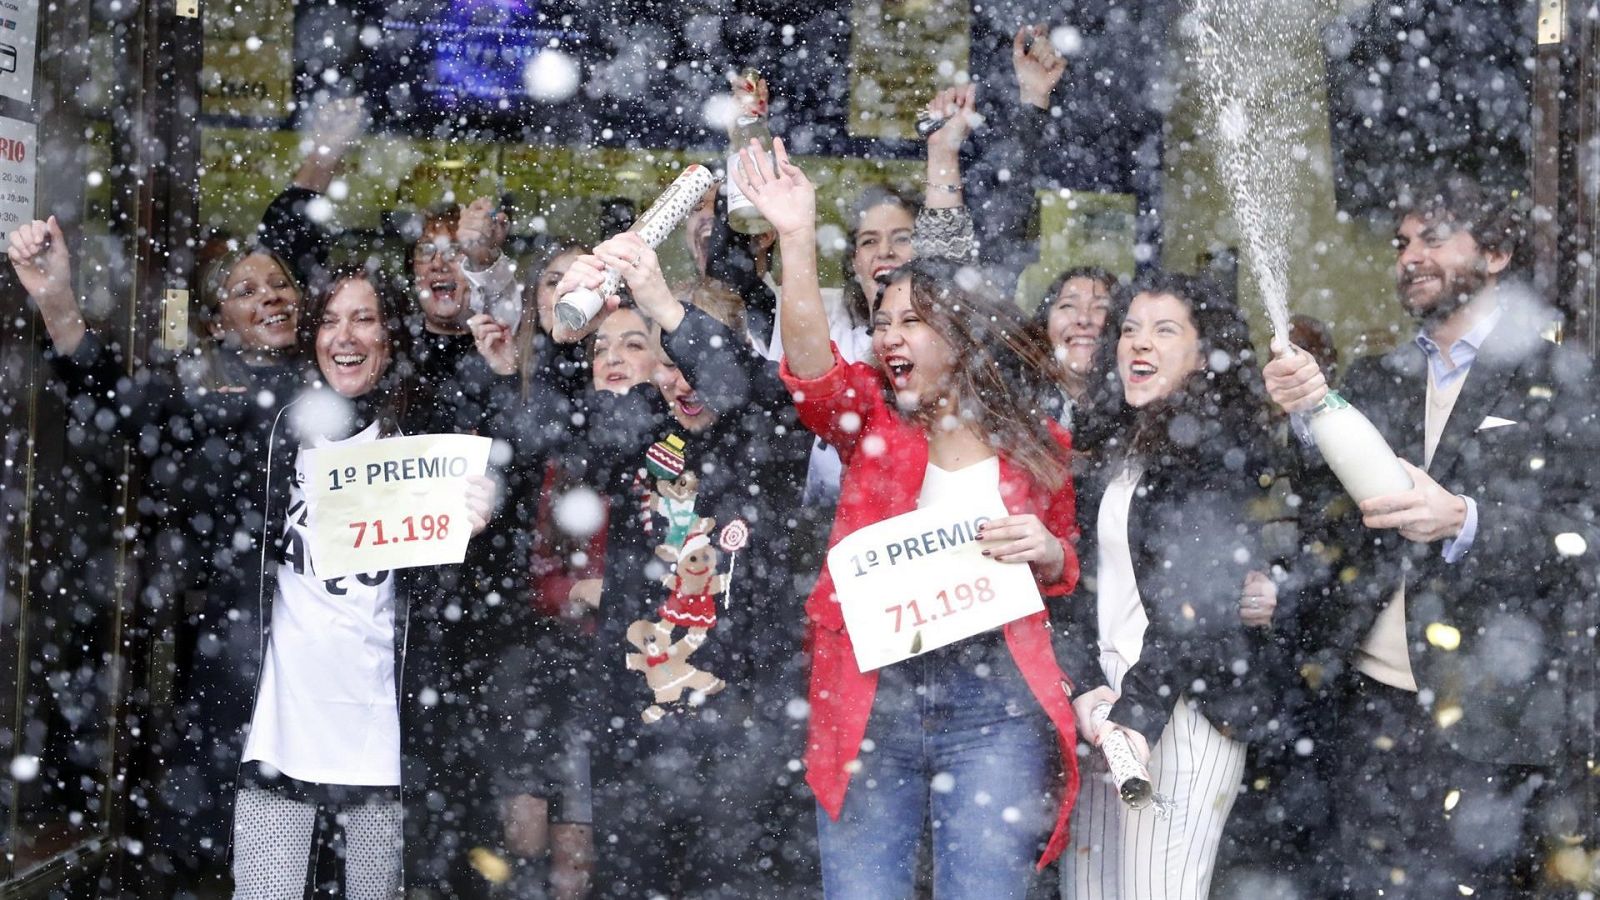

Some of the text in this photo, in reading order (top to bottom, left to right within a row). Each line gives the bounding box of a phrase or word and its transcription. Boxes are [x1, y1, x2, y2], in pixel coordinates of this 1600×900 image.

[366, 456, 468, 486] PREMIO
[349, 514, 450, 549] 71.198
[885, 577, 995, 633] 71.198
